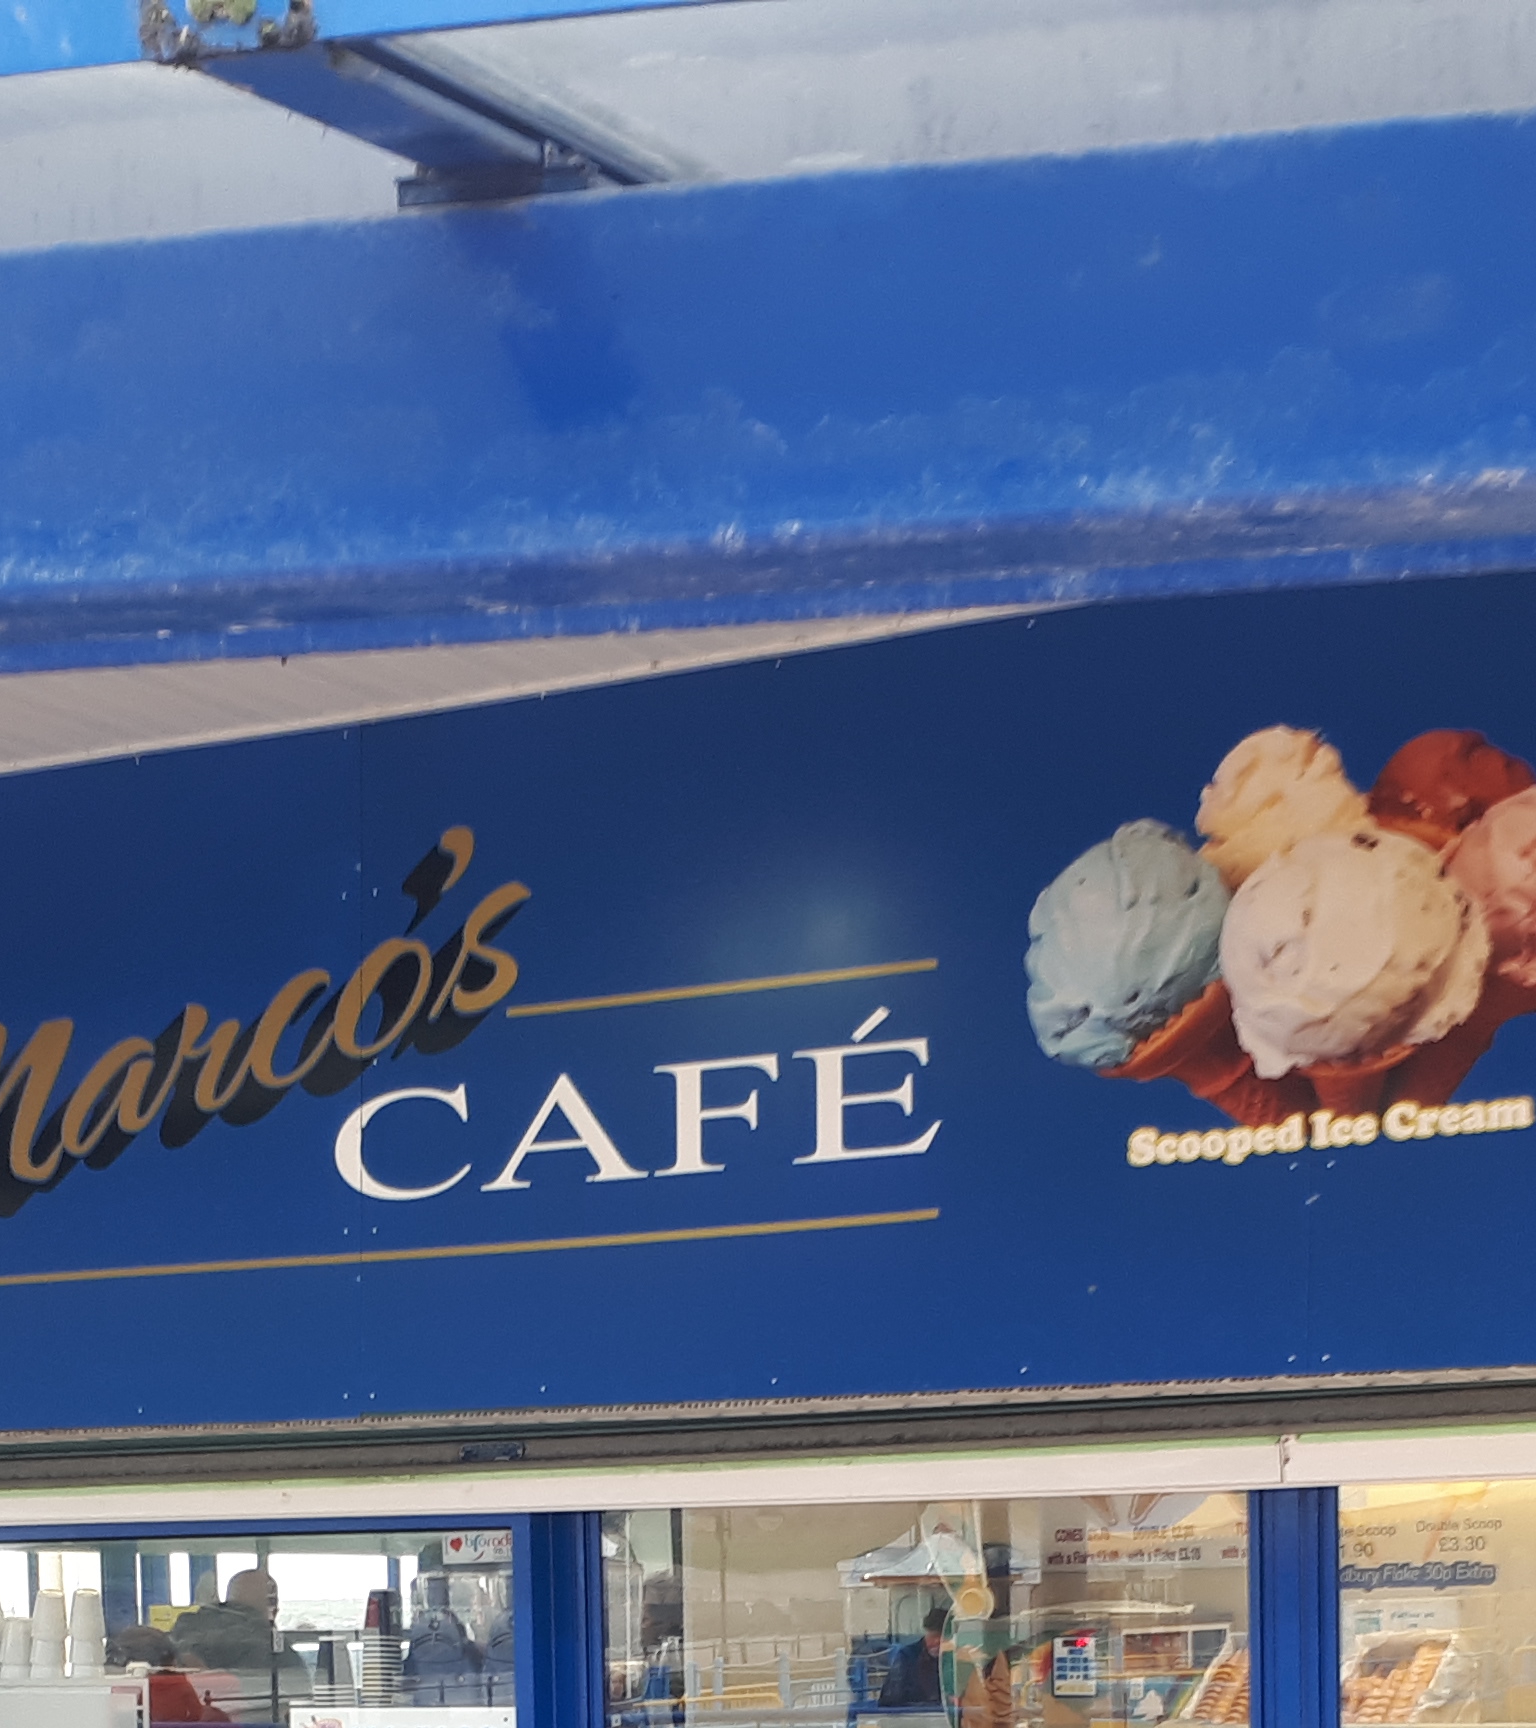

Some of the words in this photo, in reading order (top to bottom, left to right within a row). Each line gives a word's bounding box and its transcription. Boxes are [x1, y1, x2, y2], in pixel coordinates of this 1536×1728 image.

[334, 1006, 944, 1201] CAFÉ
[1127, 1112, 1307, 1167] Scooped
[1308, 1108, 1379, 1151] Ice
[1382, 1095, 1536, 1143] Cream
[1463, 1519, 1503, 1531] Scoop
